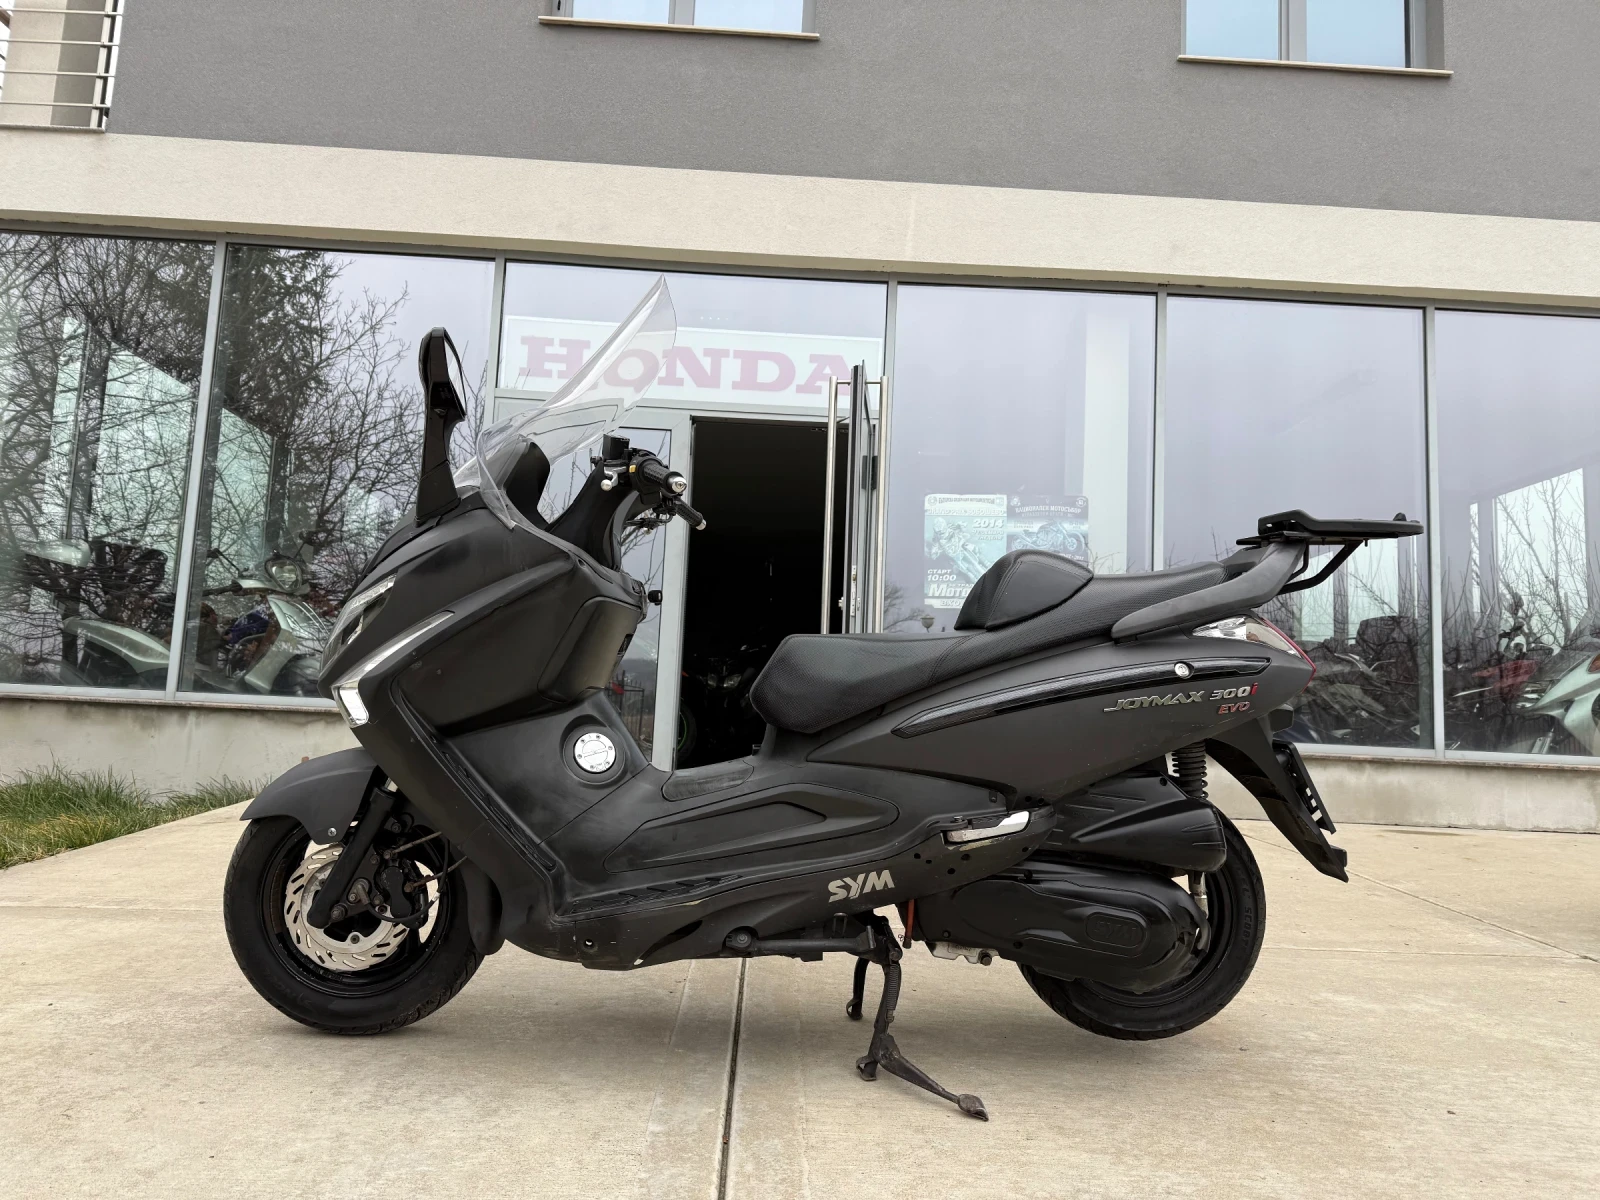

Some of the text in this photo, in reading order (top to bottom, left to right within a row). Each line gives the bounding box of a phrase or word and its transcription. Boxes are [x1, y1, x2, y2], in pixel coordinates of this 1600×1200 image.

[519, 335, 853, 396] HONDA
[972, 518, 1004, 528] 2014
[940, 599, 963, 607] ВХО
[1103, 682, 1258, 713] JOYMAX 300i
[1218, 701, 1251, 715] EVO
[827, 869, 895, 903] SYM
